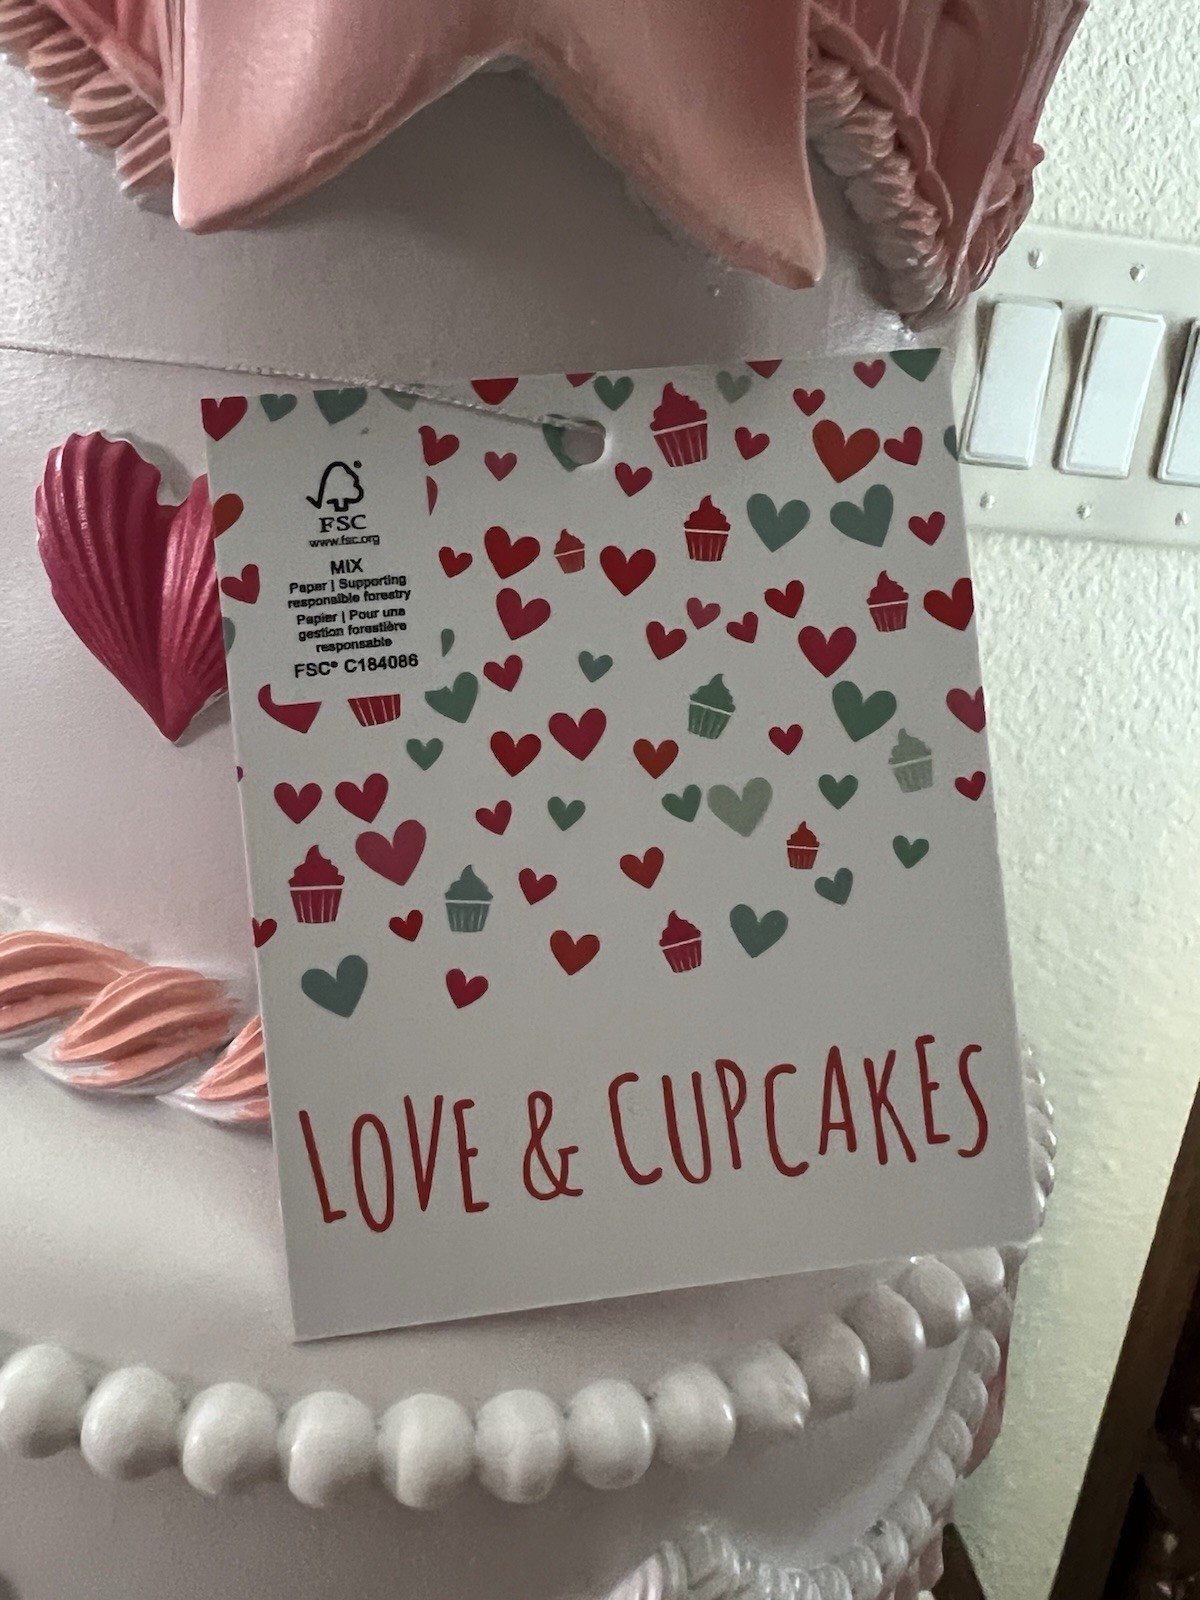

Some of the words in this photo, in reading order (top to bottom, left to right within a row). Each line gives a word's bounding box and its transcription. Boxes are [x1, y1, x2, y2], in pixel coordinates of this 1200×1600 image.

[318, 514, 367, 533] FSC
[309, 534, 380, 548] www.fsc.org
[330, 558, 364, 575] MIX
[289, 580, 328, 595] Paper
[338, 575, 407, 590] Supporting
[288, 592, 360, 608] responsible
[363, 589, 411, 602] forestry
[297, 611, 338, 626] Papier
[349, 609, 380, 621] Pour
[382, 607, 406, 618] une
[298, 626, 344, 641] gestion
[348, 620, 407, 635] forestière
[316, 637, 393, 653] responsable
[344, 653, 419, 673] C184086
[299, 1095, 490, 1233] LOVE
[522, 1090, 583, 1200] &
[607, 1034, 989, 1186] CUPCAKES
